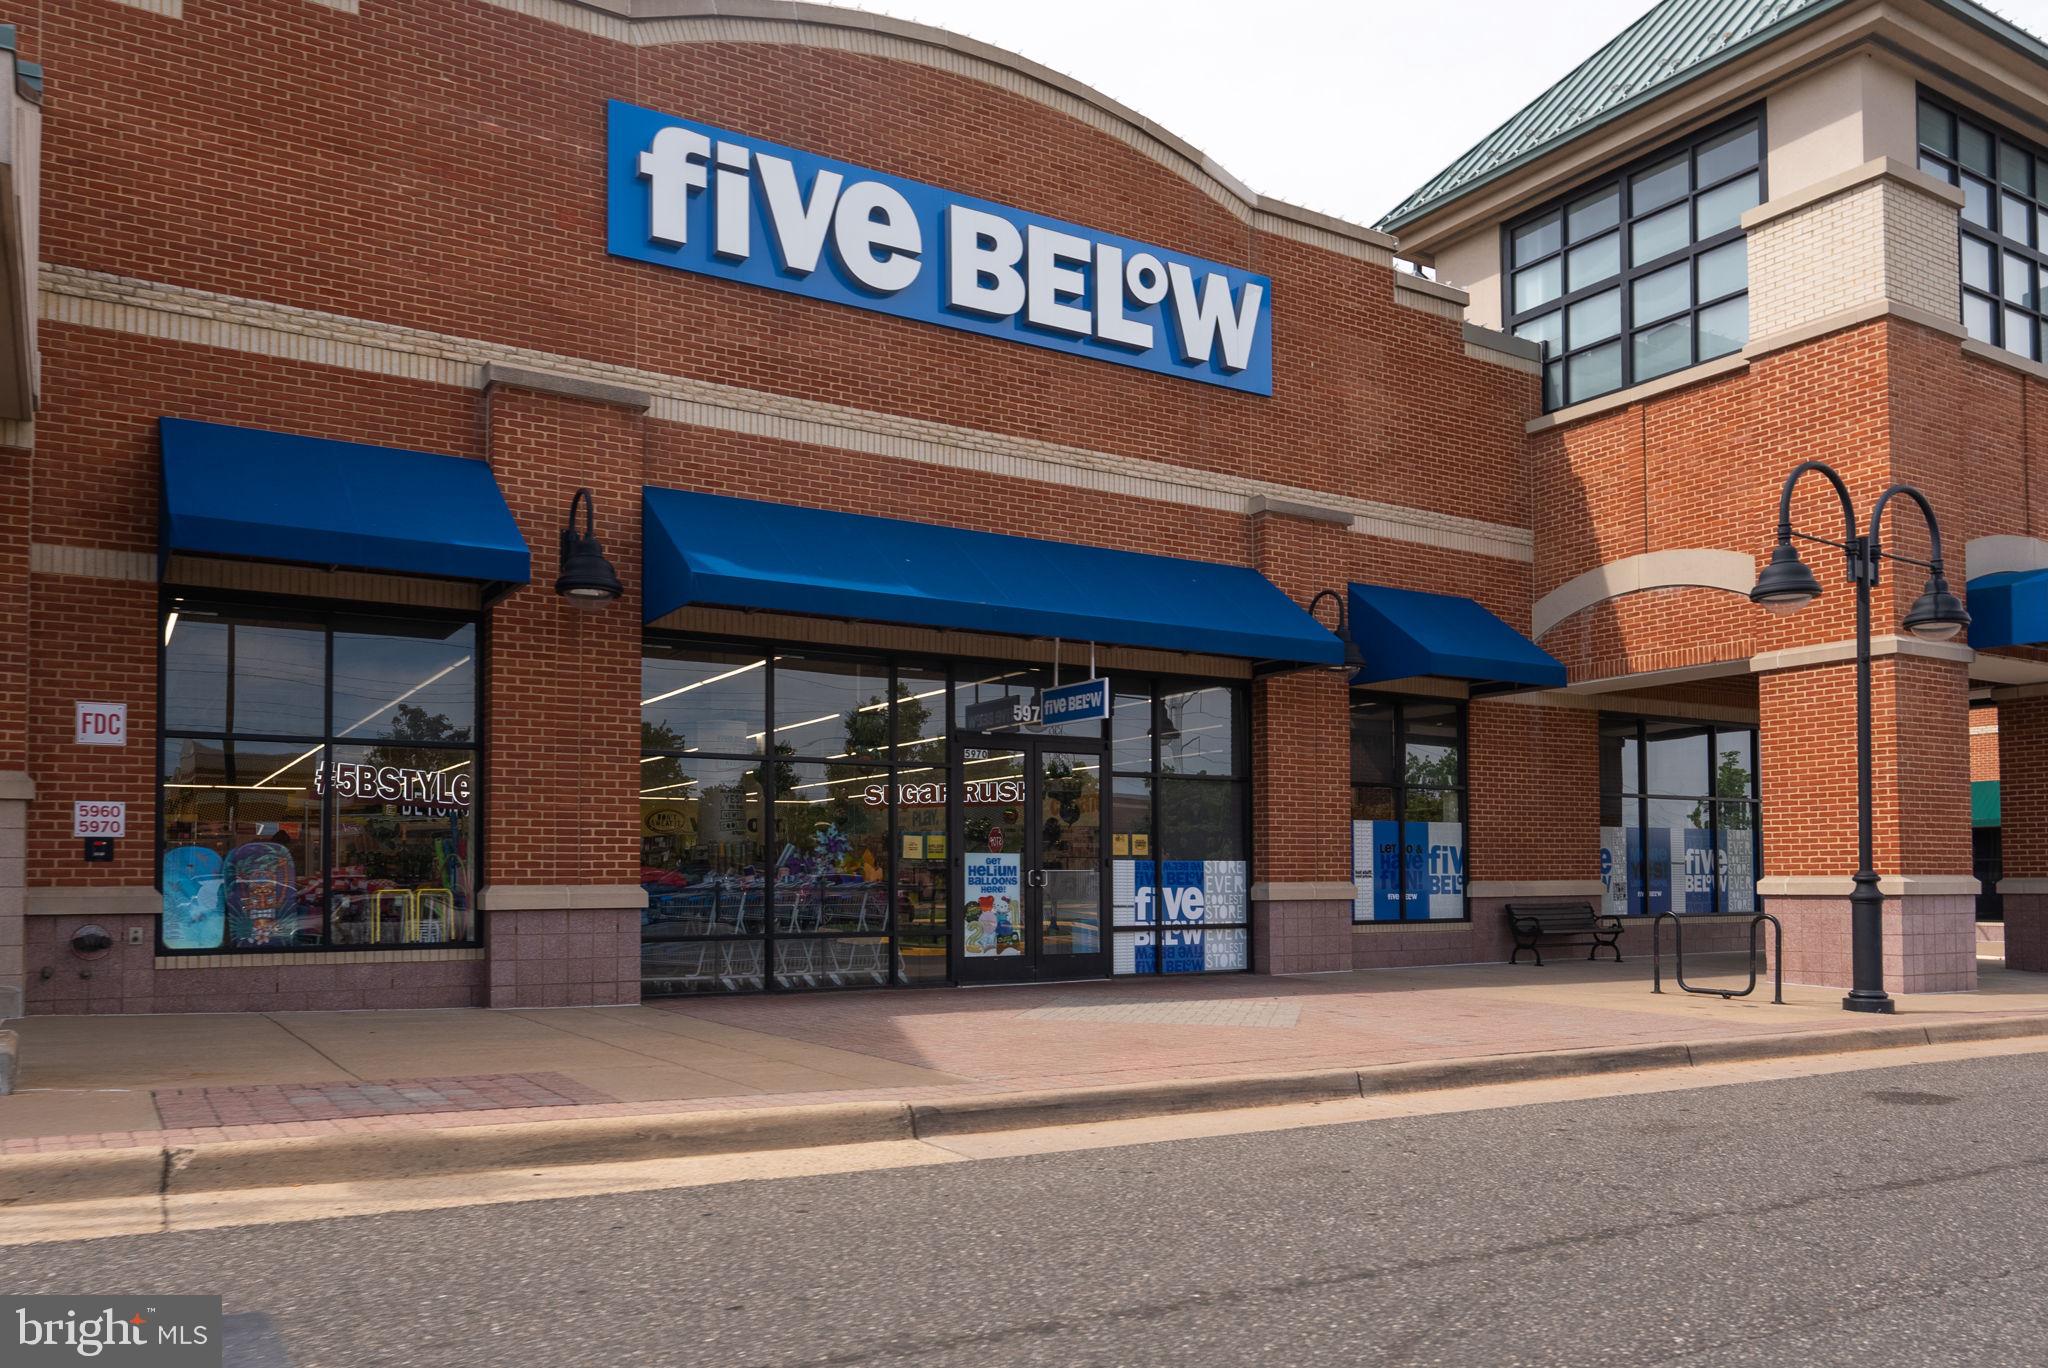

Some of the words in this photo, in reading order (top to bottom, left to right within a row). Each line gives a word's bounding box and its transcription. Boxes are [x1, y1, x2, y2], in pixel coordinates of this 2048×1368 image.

[637, 126, 923, 293] five
[945, 203, 1263, 372] BELOW
[1044, 699, 1067, 715] five
[1068, 691, 1102, 712] BELOW
[81, 712, 121, 735] FDC
[964, 749, 988, 759] 5970
[79, 805, 121, 818] 5960
[79, 820, 121, 833] 5970
[1204, 861, 1242, 874] STORE
[1205, 894, 1244, 904] COOLEST
[1205, 905, 1243, 920] STORE
[1206, 943, 1244, 953] COOLEST
[1206, 953, 1244, 968] STORE
